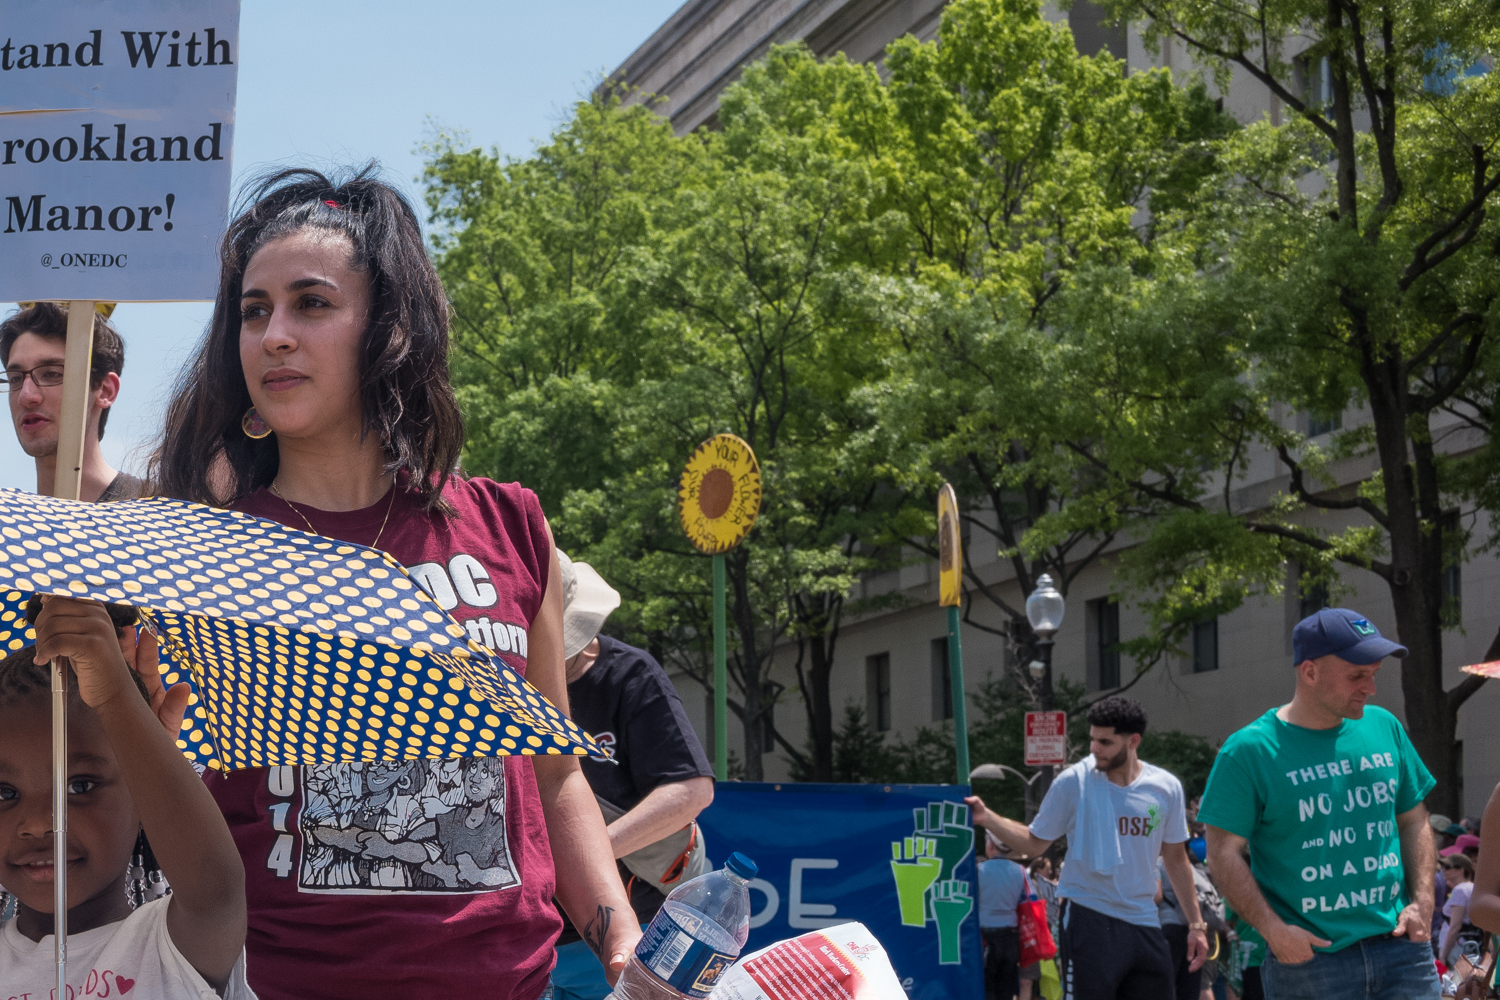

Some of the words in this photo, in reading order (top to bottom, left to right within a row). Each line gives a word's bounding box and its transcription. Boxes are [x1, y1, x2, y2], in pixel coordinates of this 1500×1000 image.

[120, 27, 234, 69] With
[3, 193, 176, 234] Manor!
[715, 443, 739, 467] YOUR
[1286, 759, 1353, 786] THERE
[1360, 752, 1394, 771] ARE
[1298, 793, 1332, 822] NO
[1302, 838, 1324, 849] AND
[1329, 827, 1356, 847] NO
[1301, 863, 1333, 882] ON
[1342, 860, 1357, 876] A
[1301, 886, 1386, 913] PLANET
